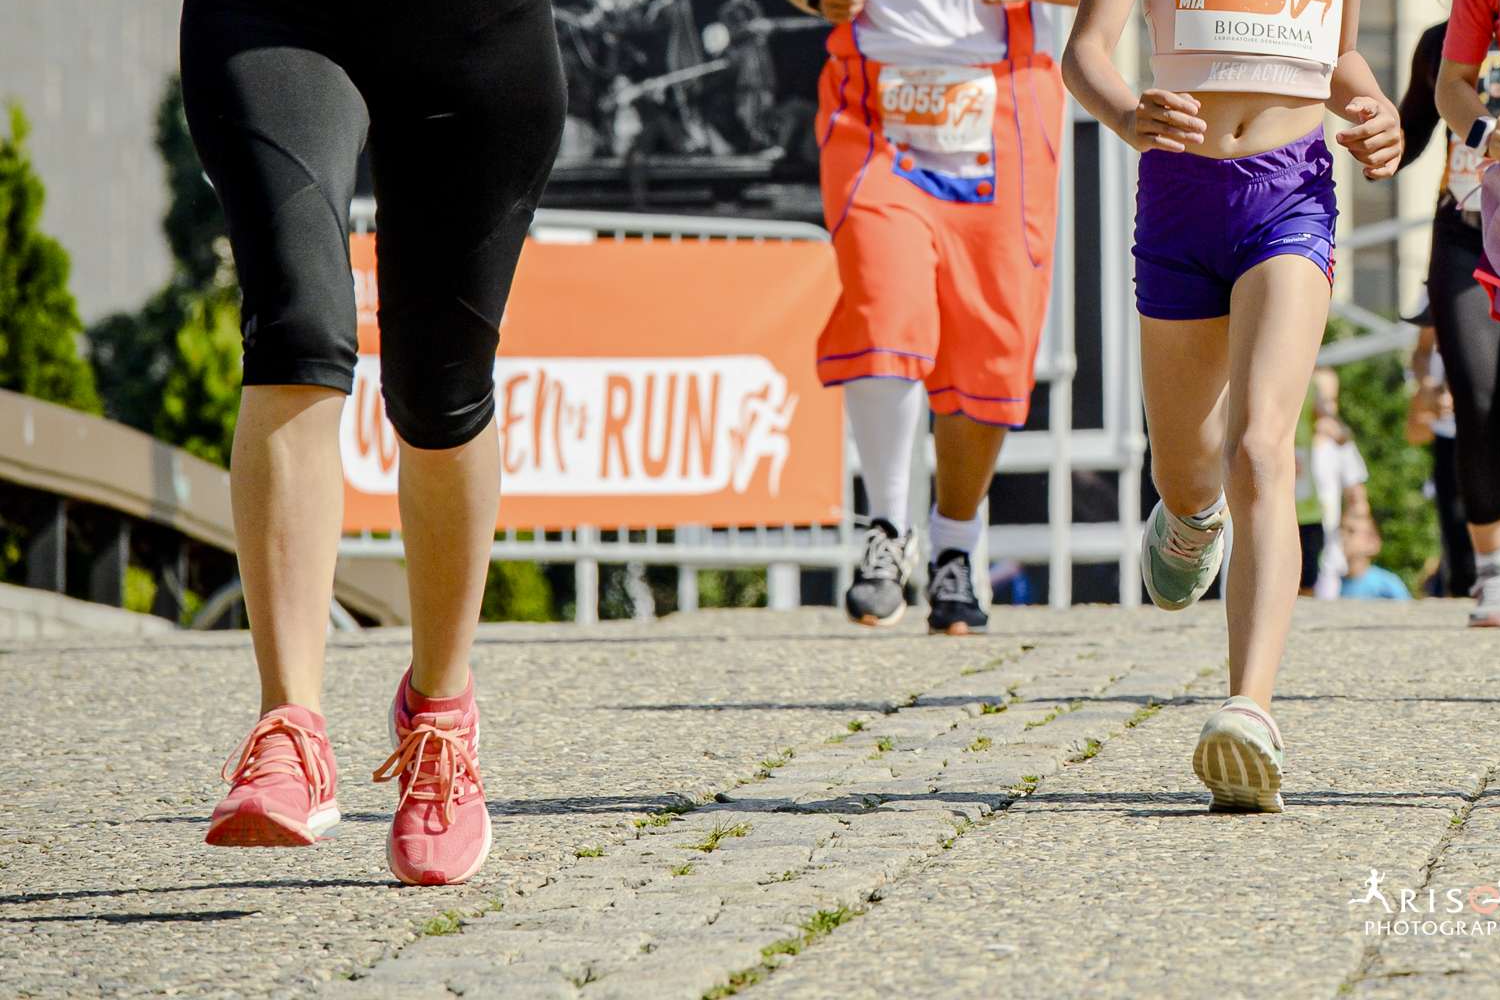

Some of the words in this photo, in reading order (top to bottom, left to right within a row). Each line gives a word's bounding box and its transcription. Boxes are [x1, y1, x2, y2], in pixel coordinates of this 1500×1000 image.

[1215, 20, 1312, 44] BIODERMA
[1208, 61, 1248, 82] KEEP
[1252, 64, 1300, 84] ACTIVE
[882, 83, 946, 114] 6055
[599, 372, 722, 478] RUN
